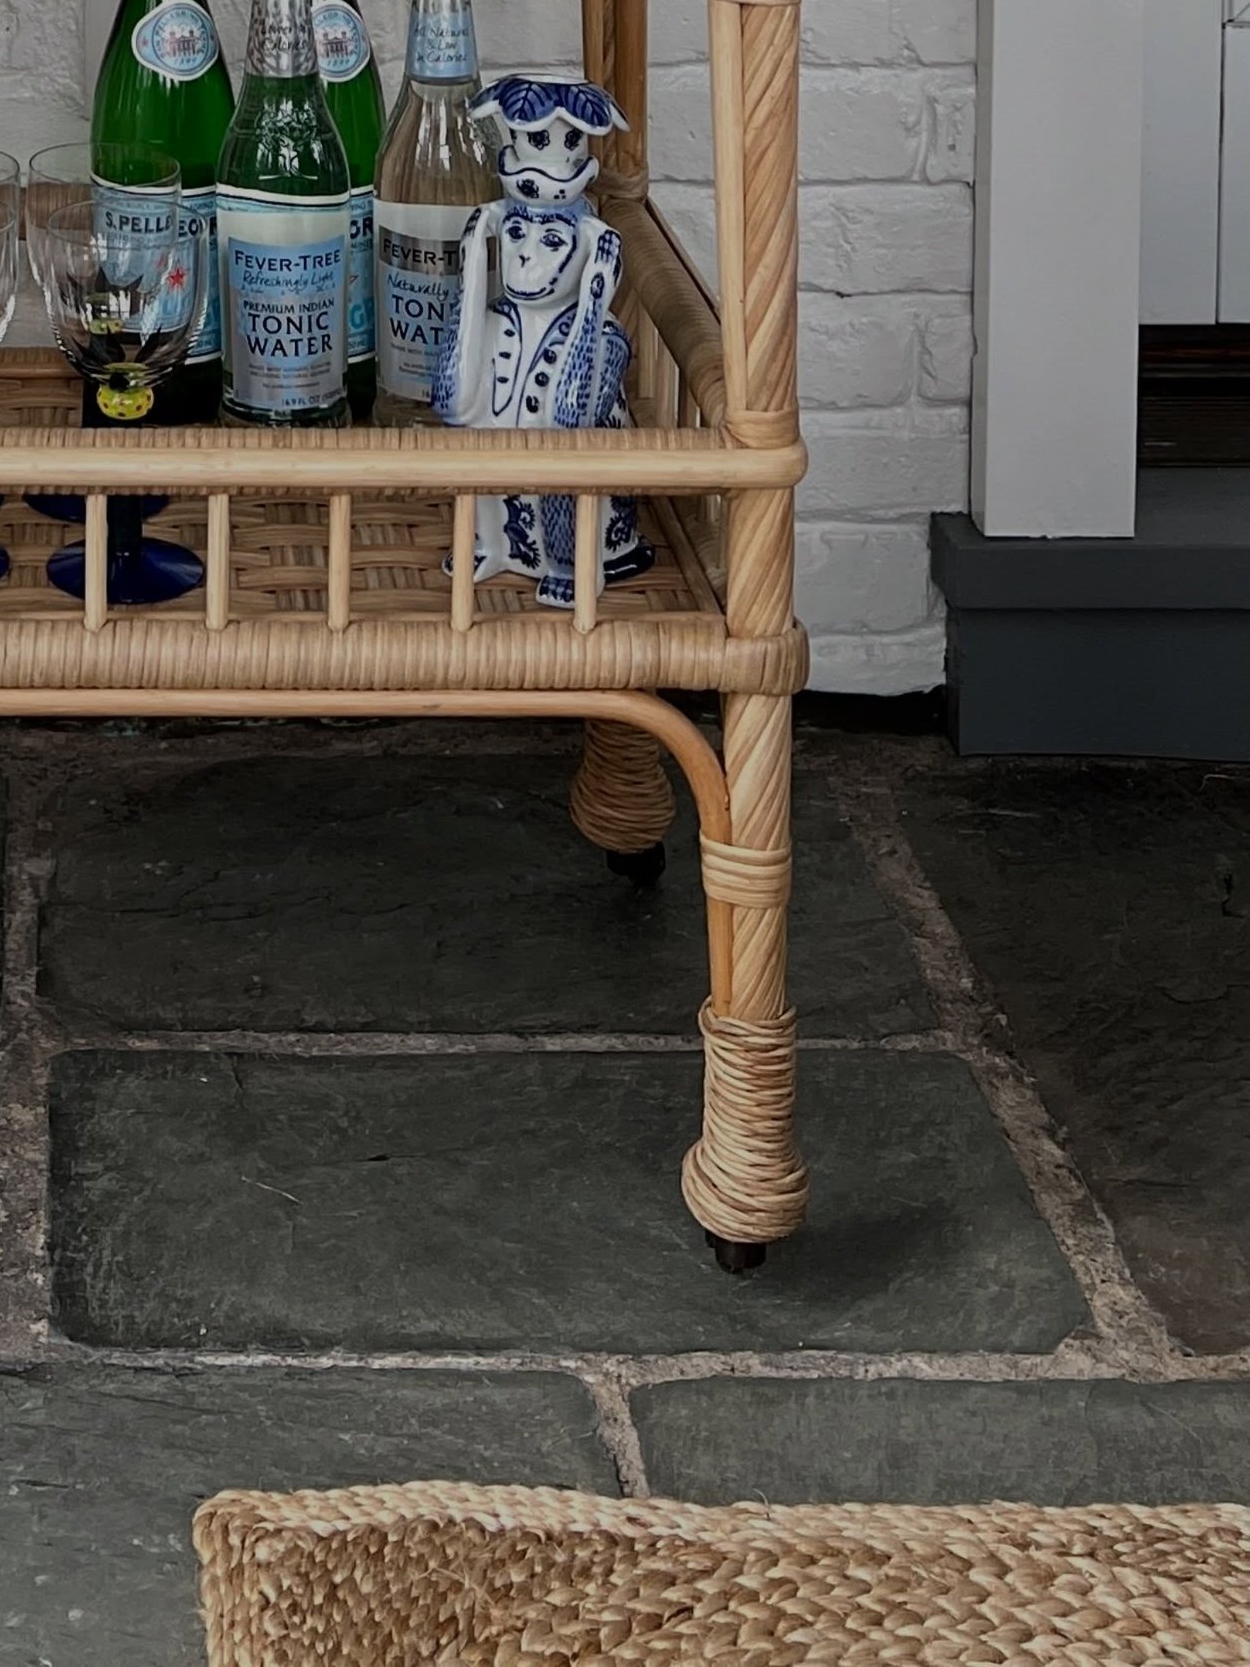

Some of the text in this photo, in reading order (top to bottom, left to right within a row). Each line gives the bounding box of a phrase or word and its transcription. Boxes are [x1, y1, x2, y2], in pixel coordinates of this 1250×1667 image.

[234, 248, 341, 272] FEVER-TREE
[243, 269, 308, 292] Refreshingly
[387, 272, 450, 302] Naturally
[243, 297, 335, 314] PREMIUM INDIAN
[248, 310, 329, 335] TONIC
[246, 333, 333, 357] WATER
